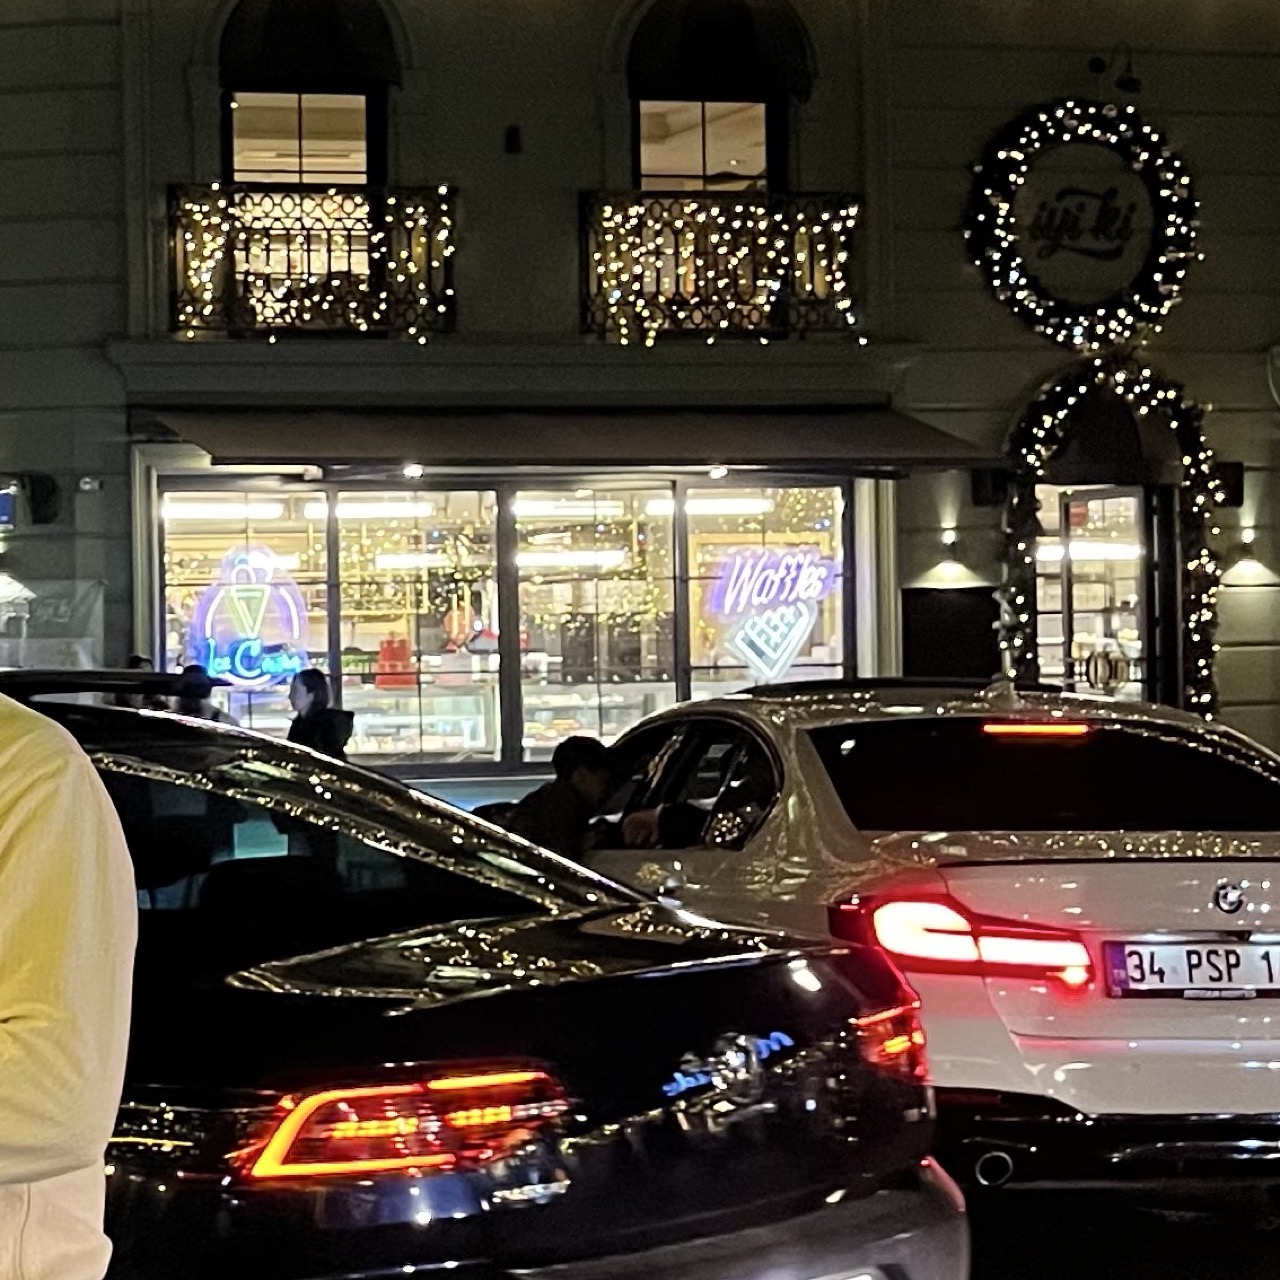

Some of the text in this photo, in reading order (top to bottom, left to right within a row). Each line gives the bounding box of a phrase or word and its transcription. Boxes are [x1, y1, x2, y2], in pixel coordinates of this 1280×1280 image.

[723, 550, 828, 615] Waffles
[1126, 950, 1166, 983] 34
[1185, 949, 1241, 983] PSP
